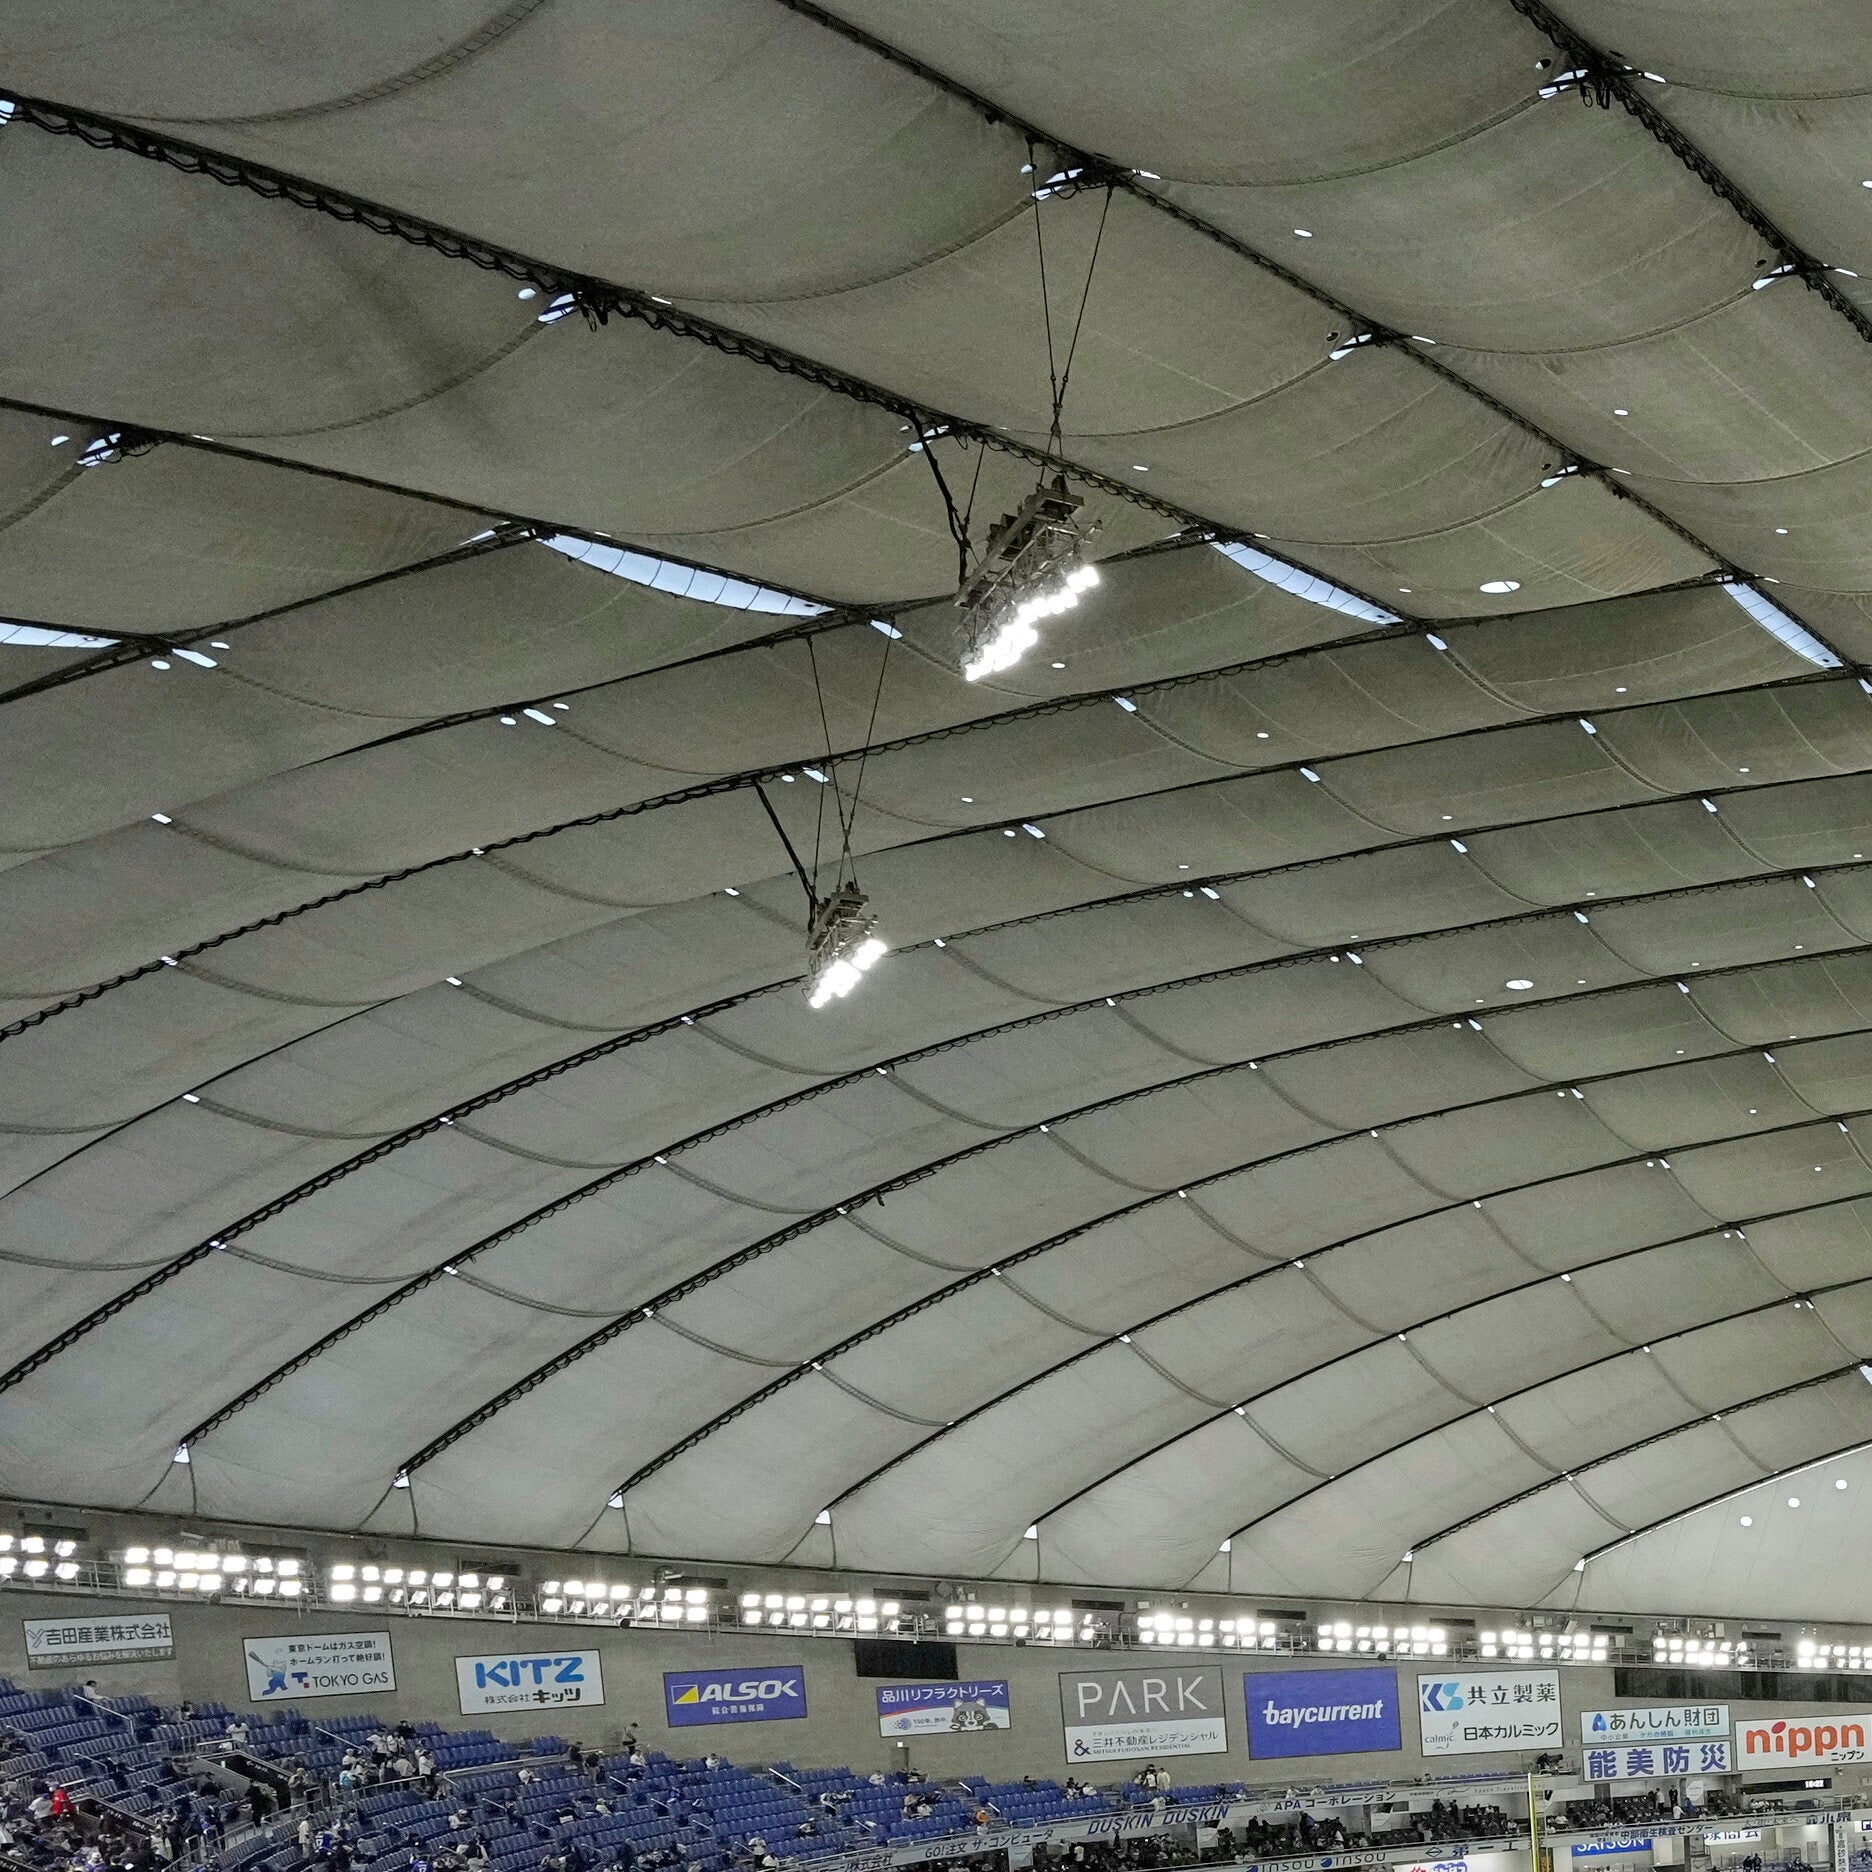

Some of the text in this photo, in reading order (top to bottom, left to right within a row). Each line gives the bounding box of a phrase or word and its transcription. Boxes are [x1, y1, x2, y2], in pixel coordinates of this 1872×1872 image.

[313, 1672, 389, 1688] TOKYO GAS
[475, 1657, 584, 1690] KITZ
[532, 1689, 582, 1704] キッツ
[700, 1679, 800, 1703] ALSOK
[882, 1684, 1005, 1704] 品川リフラクトリーズ
[1077, 1675, 1208, 1718] PARK
[1467, 1682, 1557, 1707] 共立製薬
[1263, 1699, 1384, 1729] baycurrent
[1610, 1708, 1720, 1730] あんしん財団
[1464, 1722, 1559, 1741] 日本カルミック
[1746, 1720, 1865, 1757] nippn
[1588, 1743, 1728, 1779] 能美防災
[1830, 1749, 1865, 1761] ニップン
[1273, 1799, 1301, 1813] APA
[1305, 1792, 1397, 1808] コーポレーション
[1088, 1813, 1153, 1835] DUSKIN
[1162, 1806, 1228, 1826] DUSKIN
